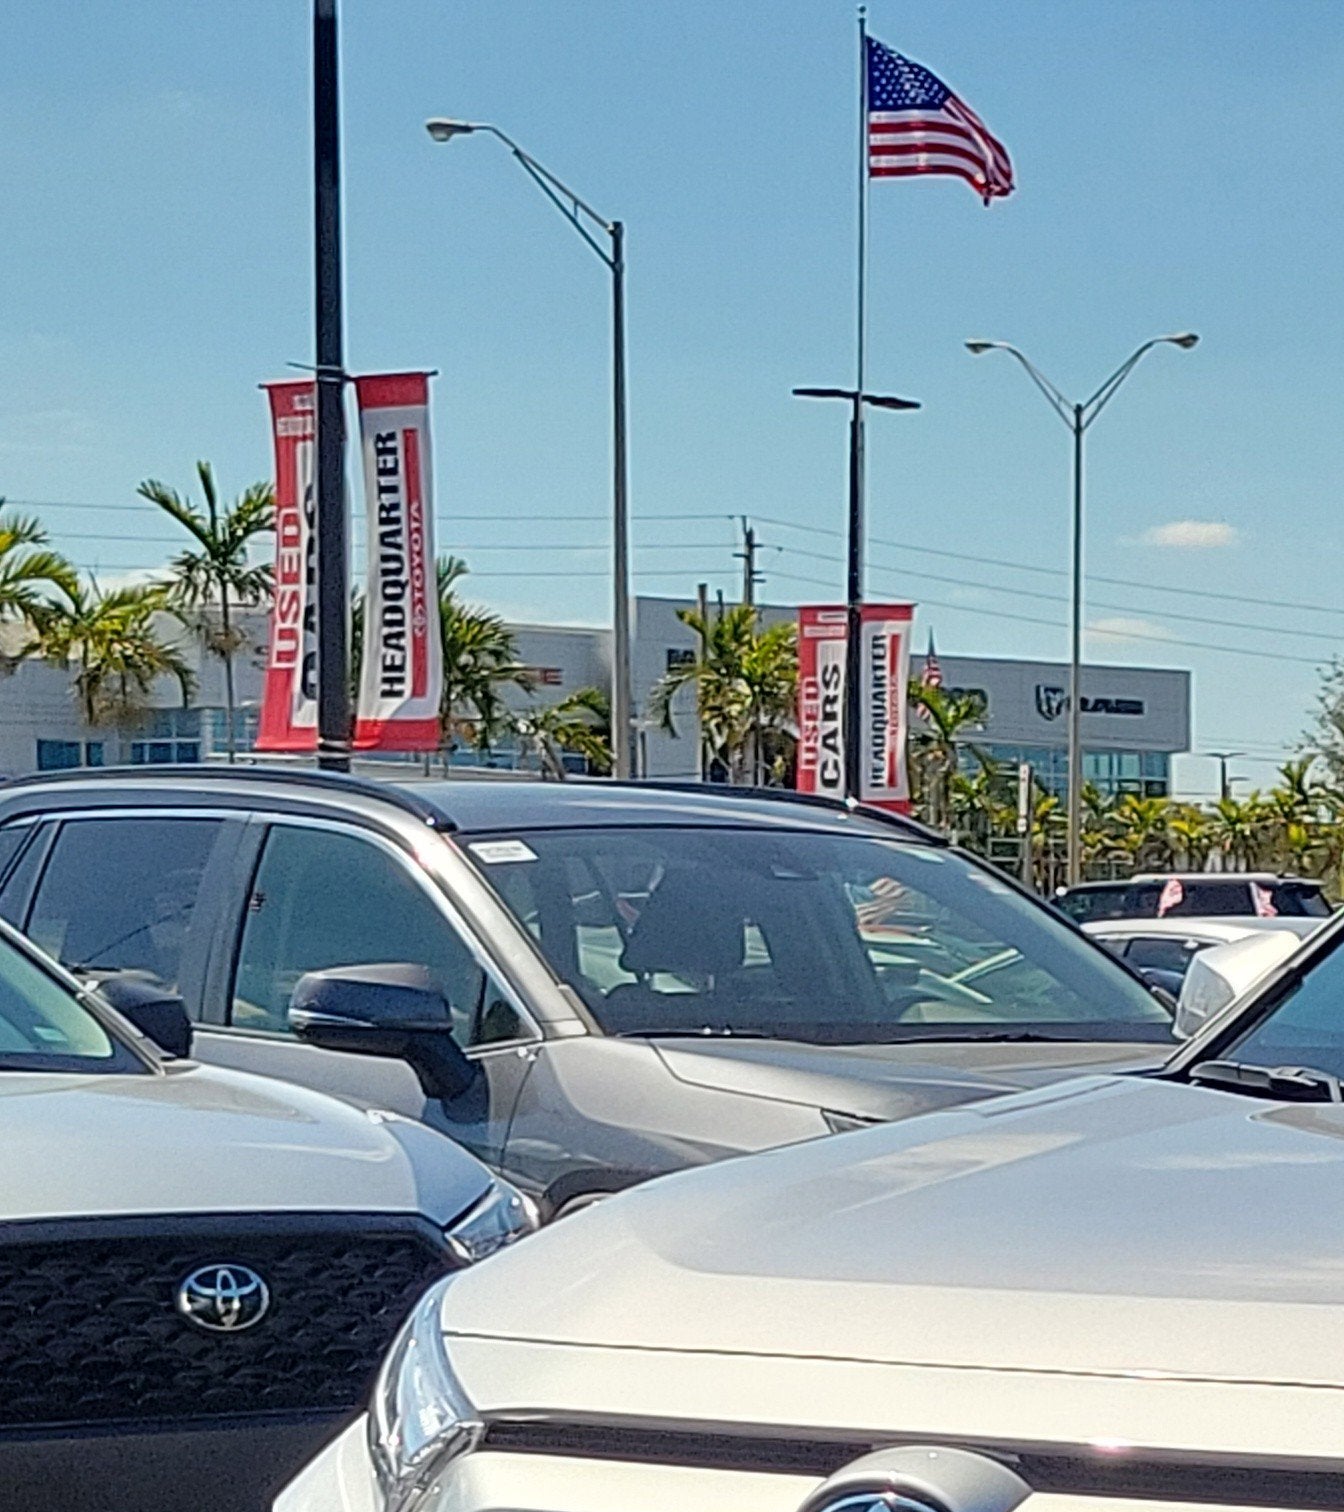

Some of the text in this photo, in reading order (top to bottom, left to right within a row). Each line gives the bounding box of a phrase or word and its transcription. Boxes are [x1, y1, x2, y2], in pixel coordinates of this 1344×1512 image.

[272, 506, 302, 669] USED
[374, 430, 408, 698] HEADQUARTER
[409, 501, 425, 599] TOYOTA
[820, 663, 841, 788] CARS
